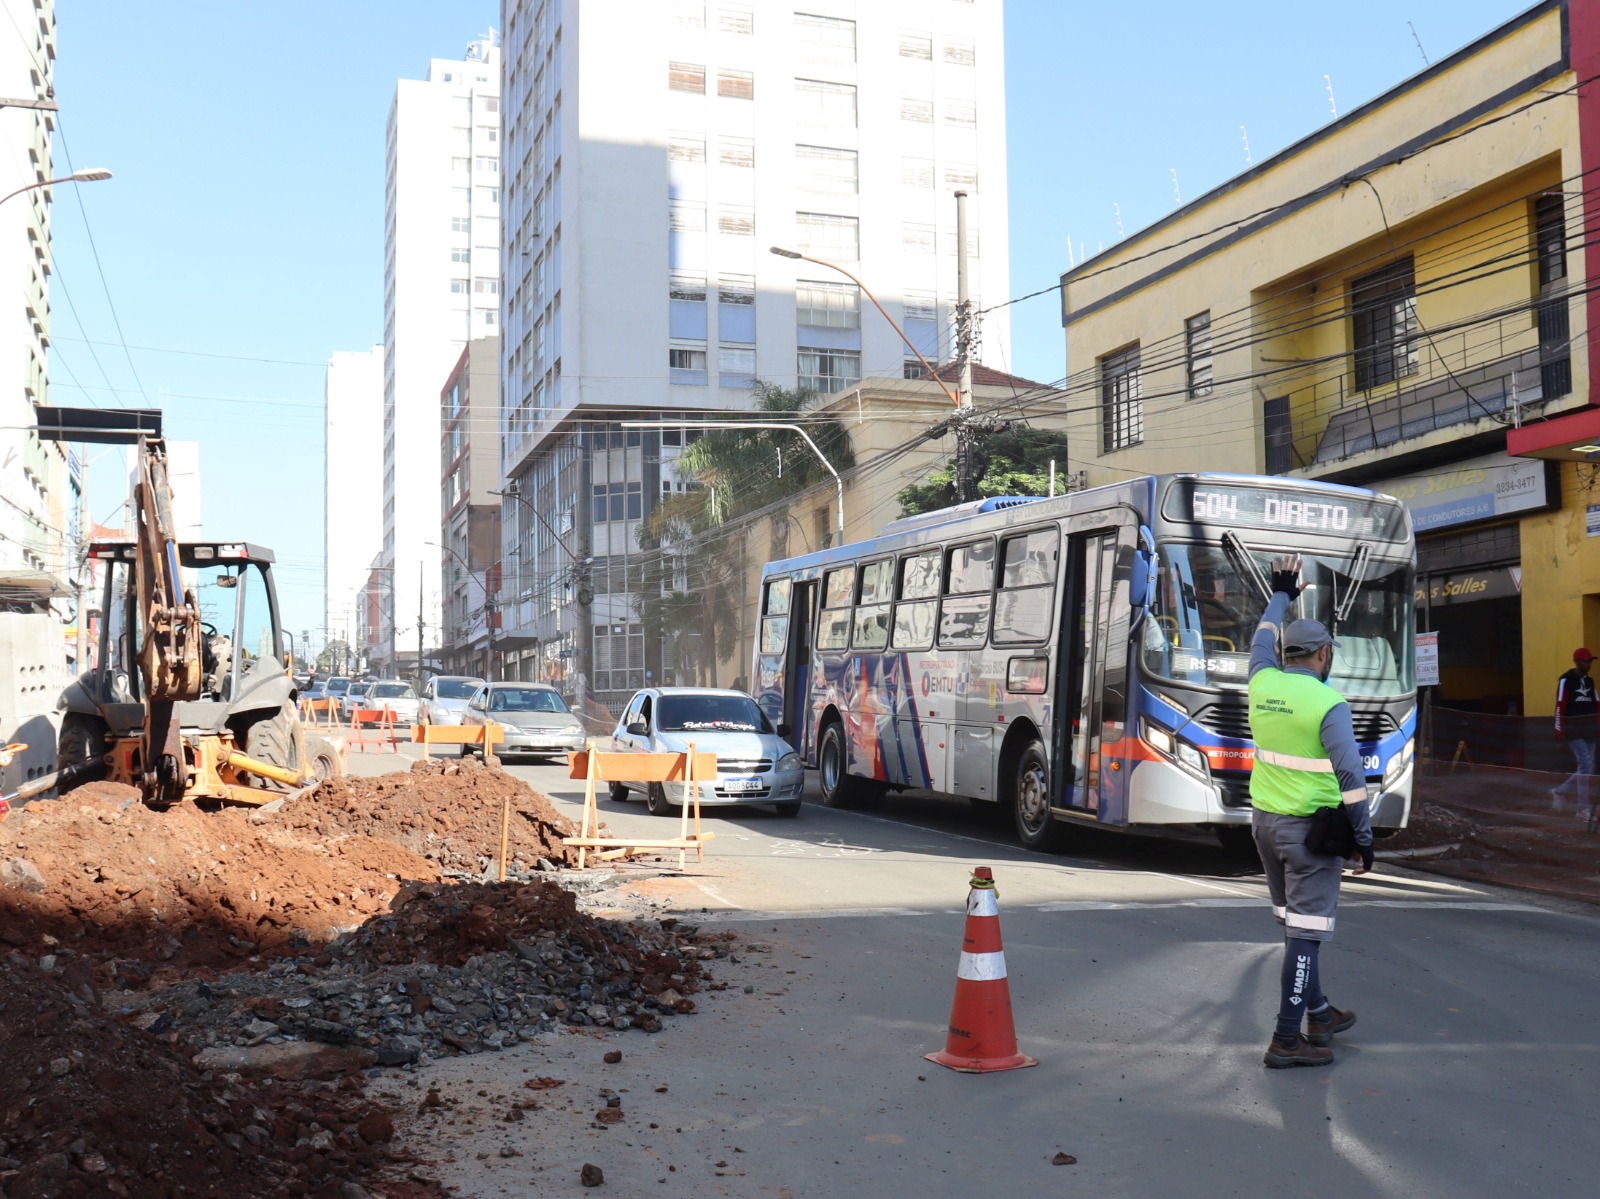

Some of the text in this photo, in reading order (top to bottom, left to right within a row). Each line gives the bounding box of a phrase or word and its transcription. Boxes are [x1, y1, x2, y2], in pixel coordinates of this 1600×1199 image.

[1423, 464, 1487, 495] Salles
[1264, 498, 1349, 530] DIRETO
[1417, 516, 1427, 526] DE
[1428, 506, 1475, 523] CONDUTORES
[1442, 577, 1487, 597] Salles
[931, 676, 953, 693] EMTU
[1207, 750, 1255, 759] METROPOLIT
[1360, 755, 1380, 769] 90
[1293, 955, 1306, 994] EMDEC
